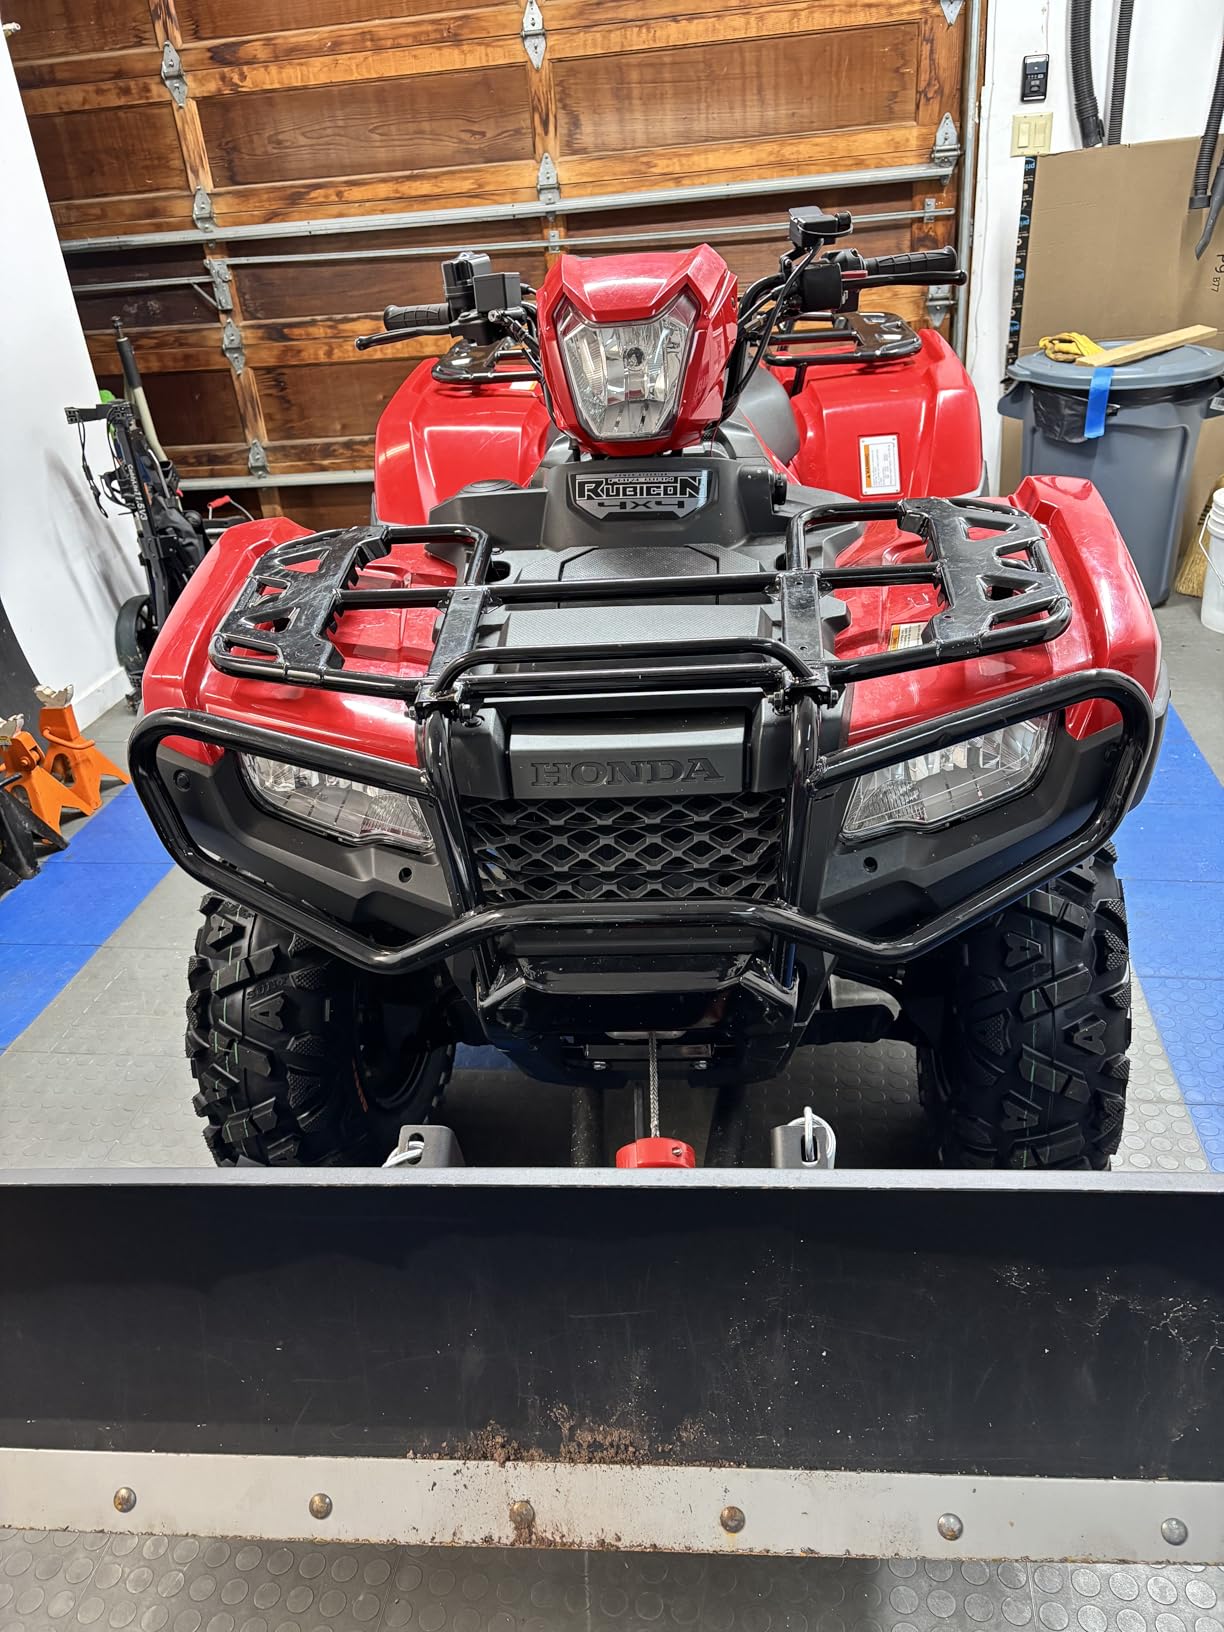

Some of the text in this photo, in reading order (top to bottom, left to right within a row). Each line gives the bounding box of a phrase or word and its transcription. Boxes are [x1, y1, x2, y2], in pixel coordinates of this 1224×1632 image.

[1211, 277, 1221, 292] B77
[576, 477, 707, 500] RUBICON
[530, 757, 725, 786] HONDA
